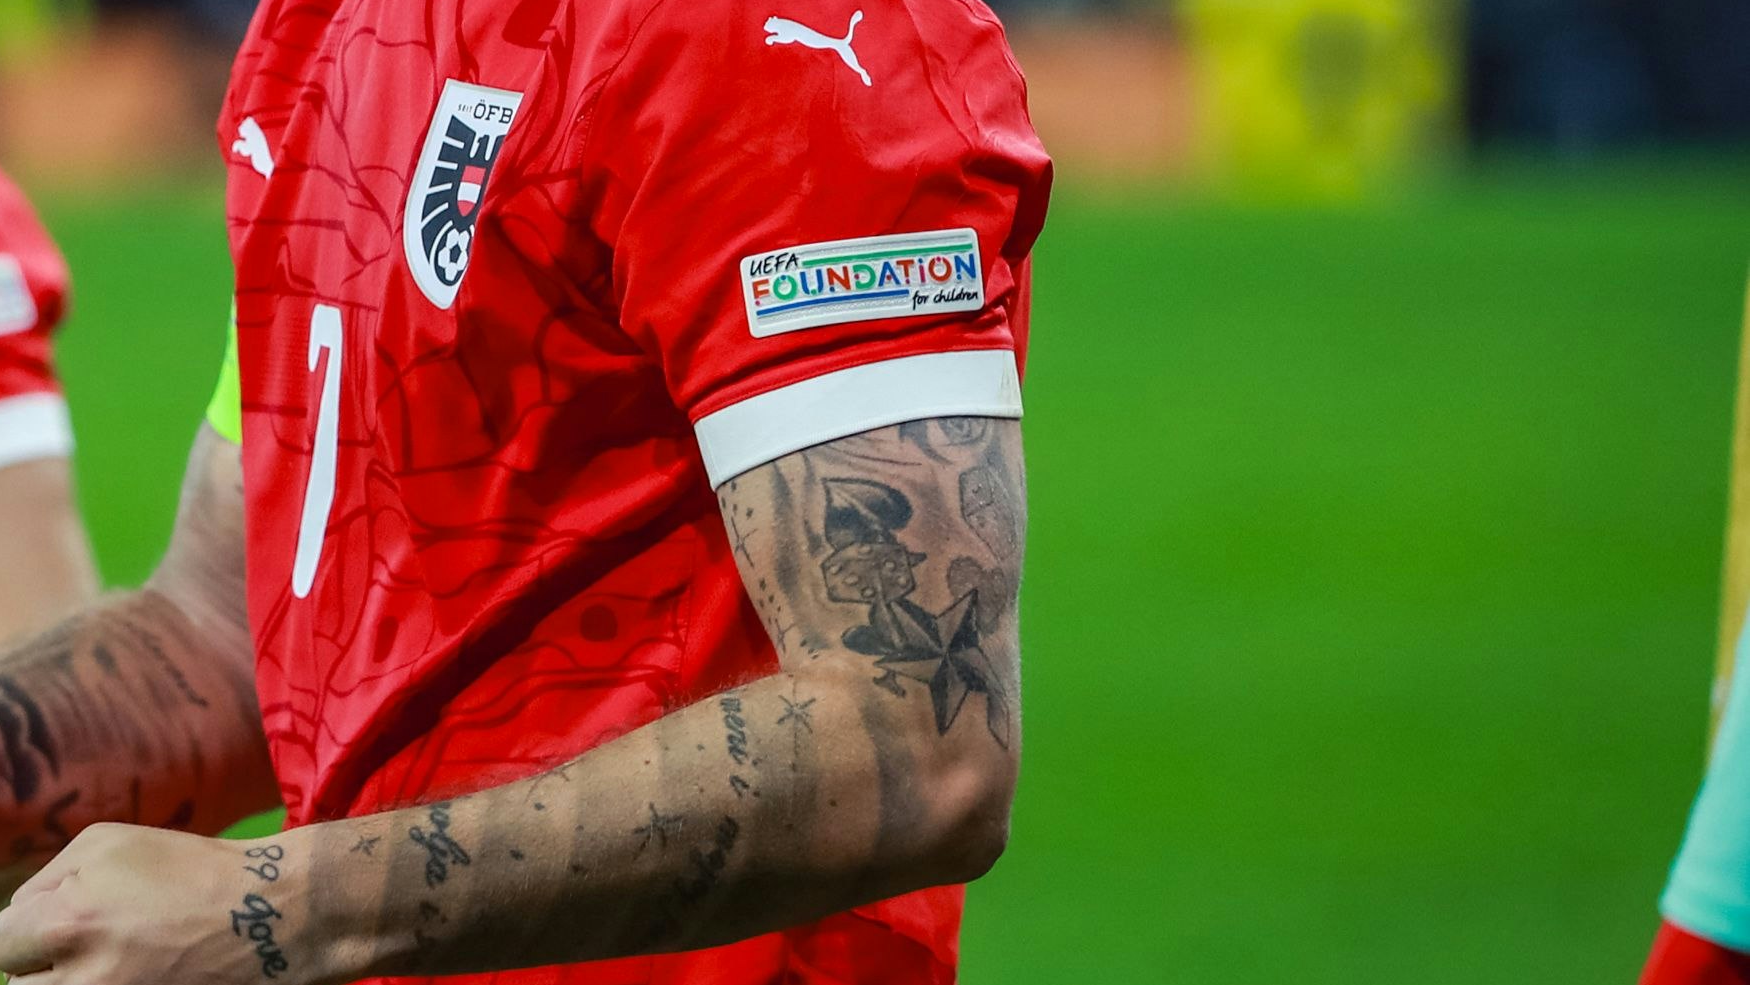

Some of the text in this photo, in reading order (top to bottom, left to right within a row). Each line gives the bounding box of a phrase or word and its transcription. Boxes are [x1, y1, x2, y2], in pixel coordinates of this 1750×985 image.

[474, 99, 514, 124] ÖFB
[750, 252, 800, 277] UEFA
[752, 253, 977, 306] FOUNDATION
[912, 288, 978, 310] for children
[292, 303, 343, 598] 7
[243, 844, 284, 882] 89
